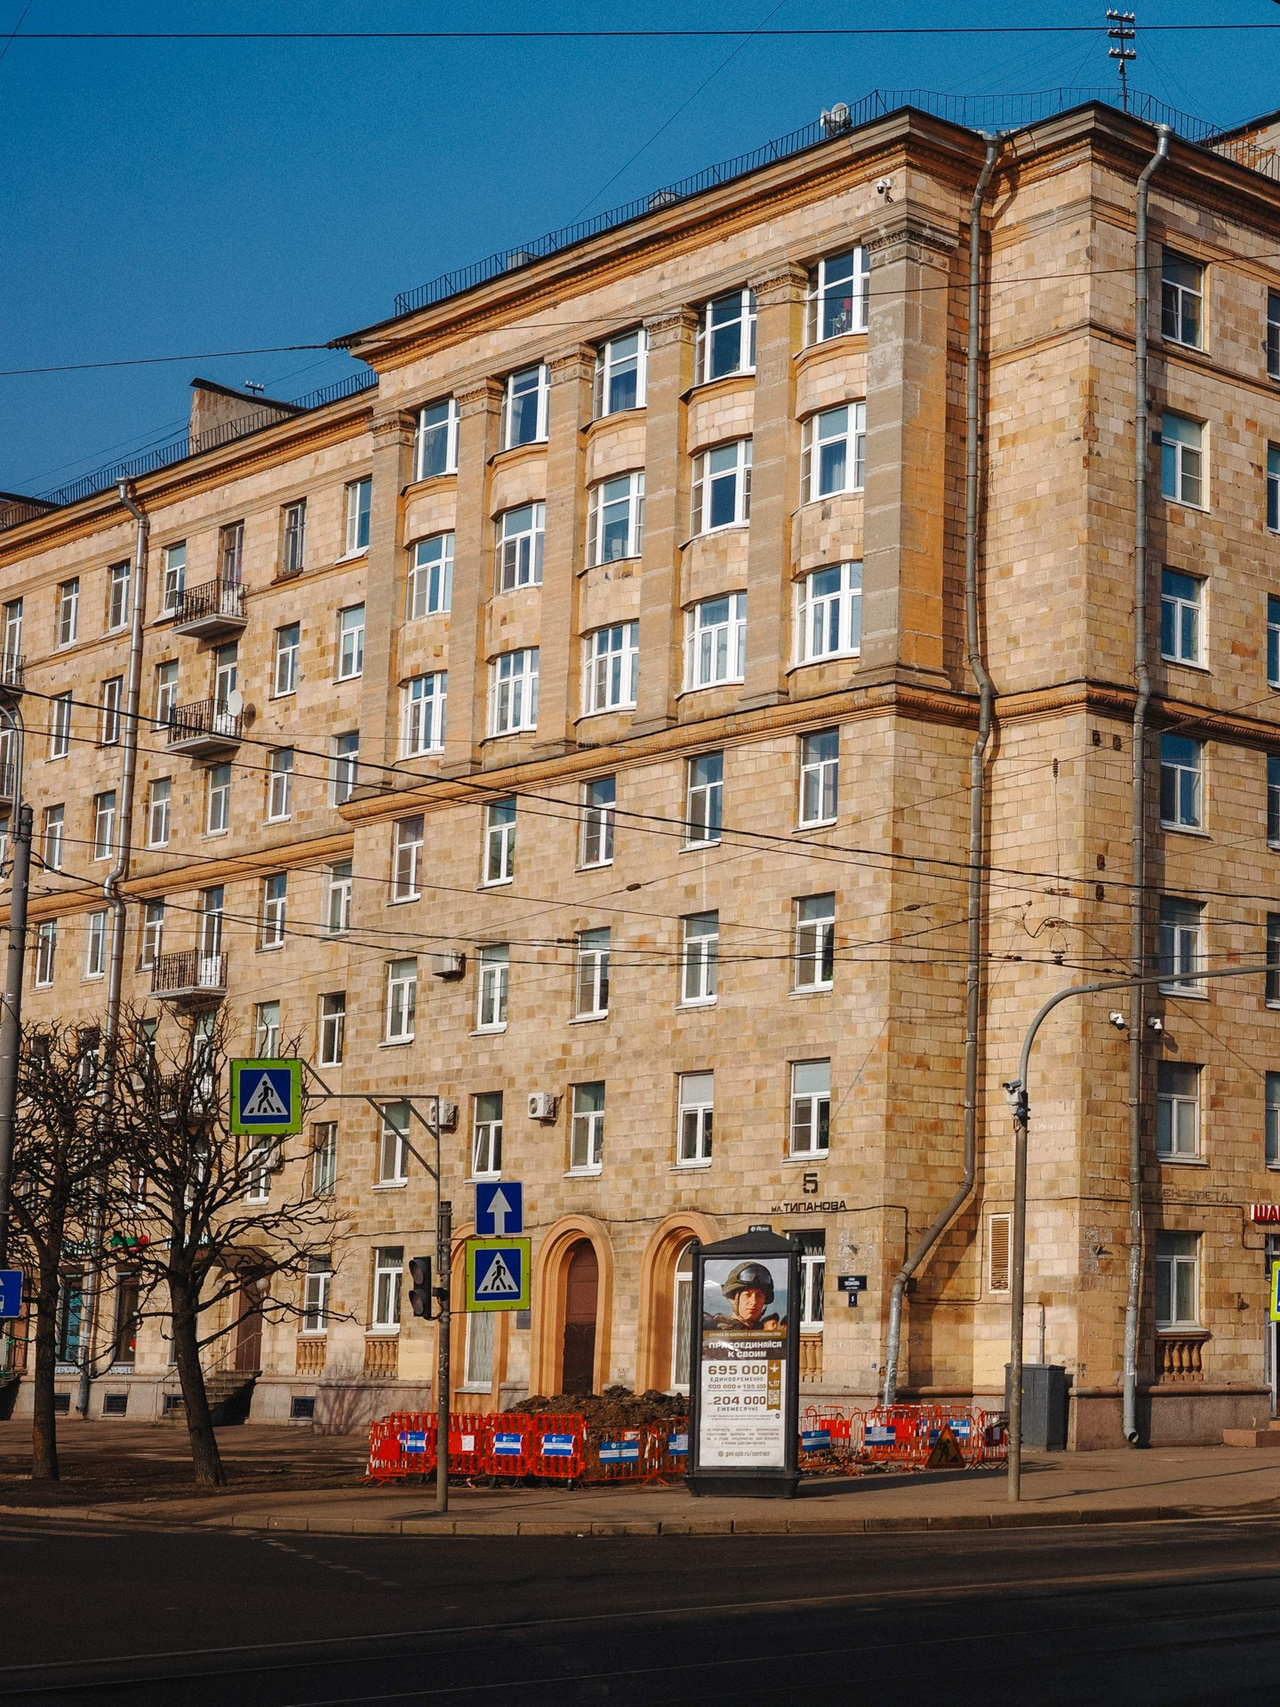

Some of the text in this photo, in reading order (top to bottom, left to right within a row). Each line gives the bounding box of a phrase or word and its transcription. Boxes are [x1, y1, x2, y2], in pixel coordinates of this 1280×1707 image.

[803, 1173, 818, 1194] 5
[783, 1200, 847, 1212] ТИПАНОВА
[708, 1365, 767, 1375] 695 000
[713, 1396, 740, 1405] 204
[744, 1396, 766, 1405] 000
